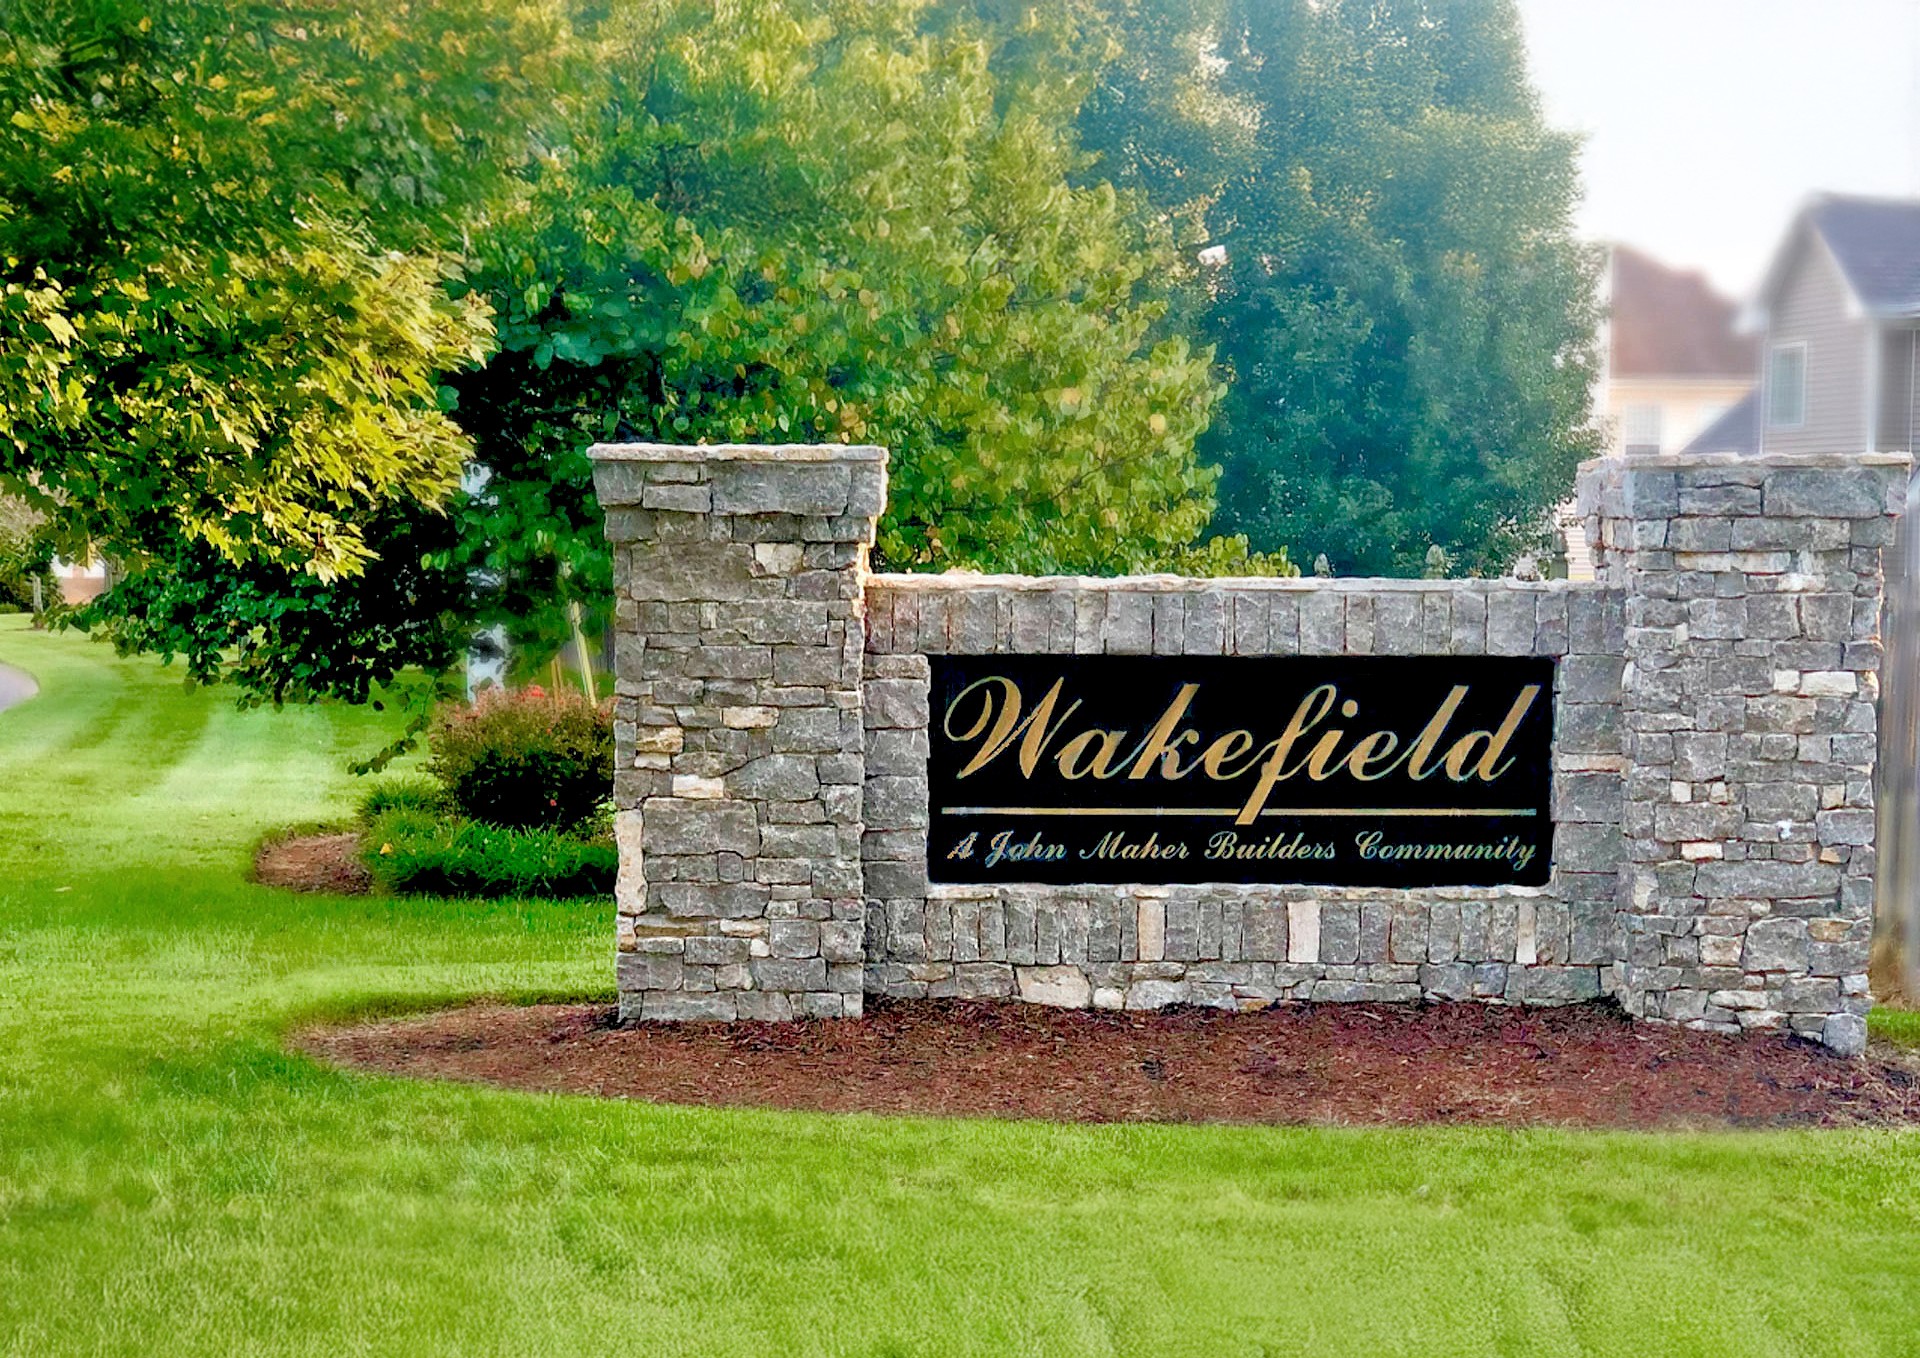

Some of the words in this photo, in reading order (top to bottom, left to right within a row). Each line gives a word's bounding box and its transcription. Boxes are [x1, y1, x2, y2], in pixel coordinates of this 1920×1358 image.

[943, 675, 1540, 825] Wakefield
[947, 831, 978, 860] A
[985, 830, 1066, 868] John
[1079, 831, 1190, 860] Maher
[1204, 830, 1336, 860] Builders
[1355, 829, 1537, 870] Community
